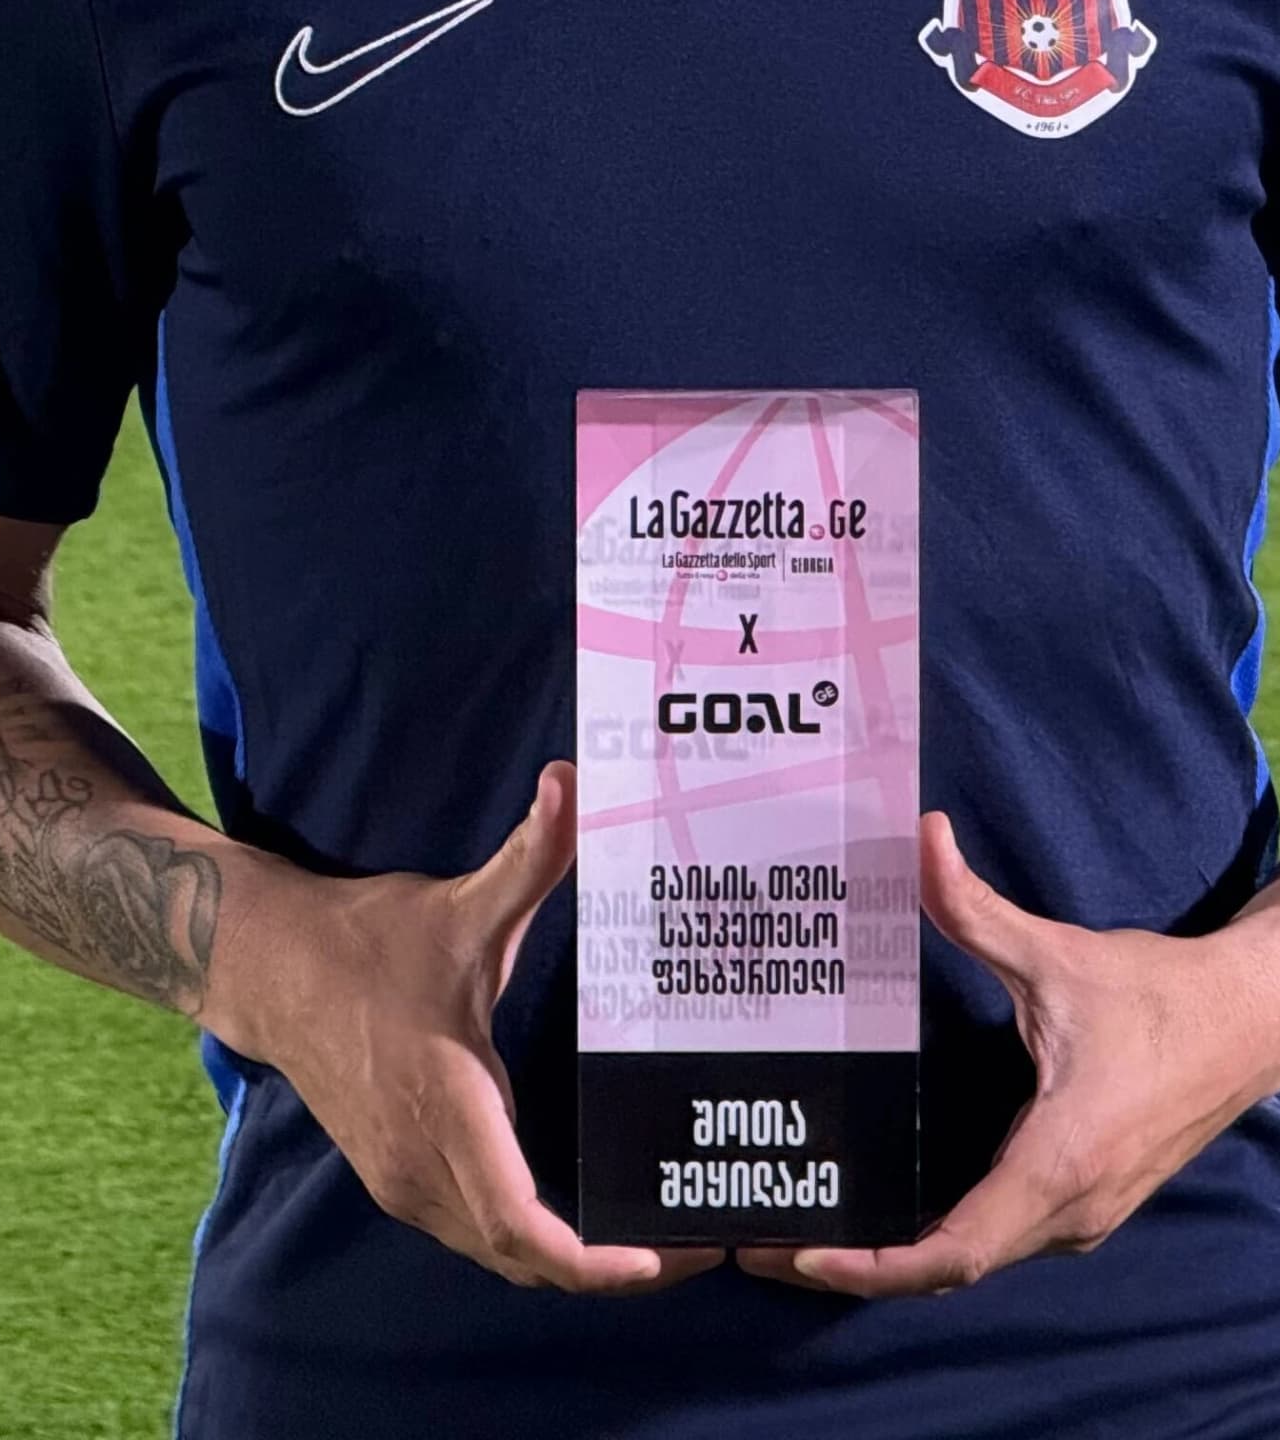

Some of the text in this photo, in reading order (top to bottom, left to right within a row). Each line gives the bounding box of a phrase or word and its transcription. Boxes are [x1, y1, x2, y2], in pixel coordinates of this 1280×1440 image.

[791, 557, 834, 574] GEORGIA
[738, 613, 759, 654] X
[658, 692, 820, 734] GOAL
[651, 865, 847, 902] მაისის თვის
[659, 911, 838, 949] საუკეთესო
[652, 958, 845, 995] ფეხბურთელი
[692, 1099, 807, 1147] შოთა
[659, 1160, 839, 1209] შეყილაძე
